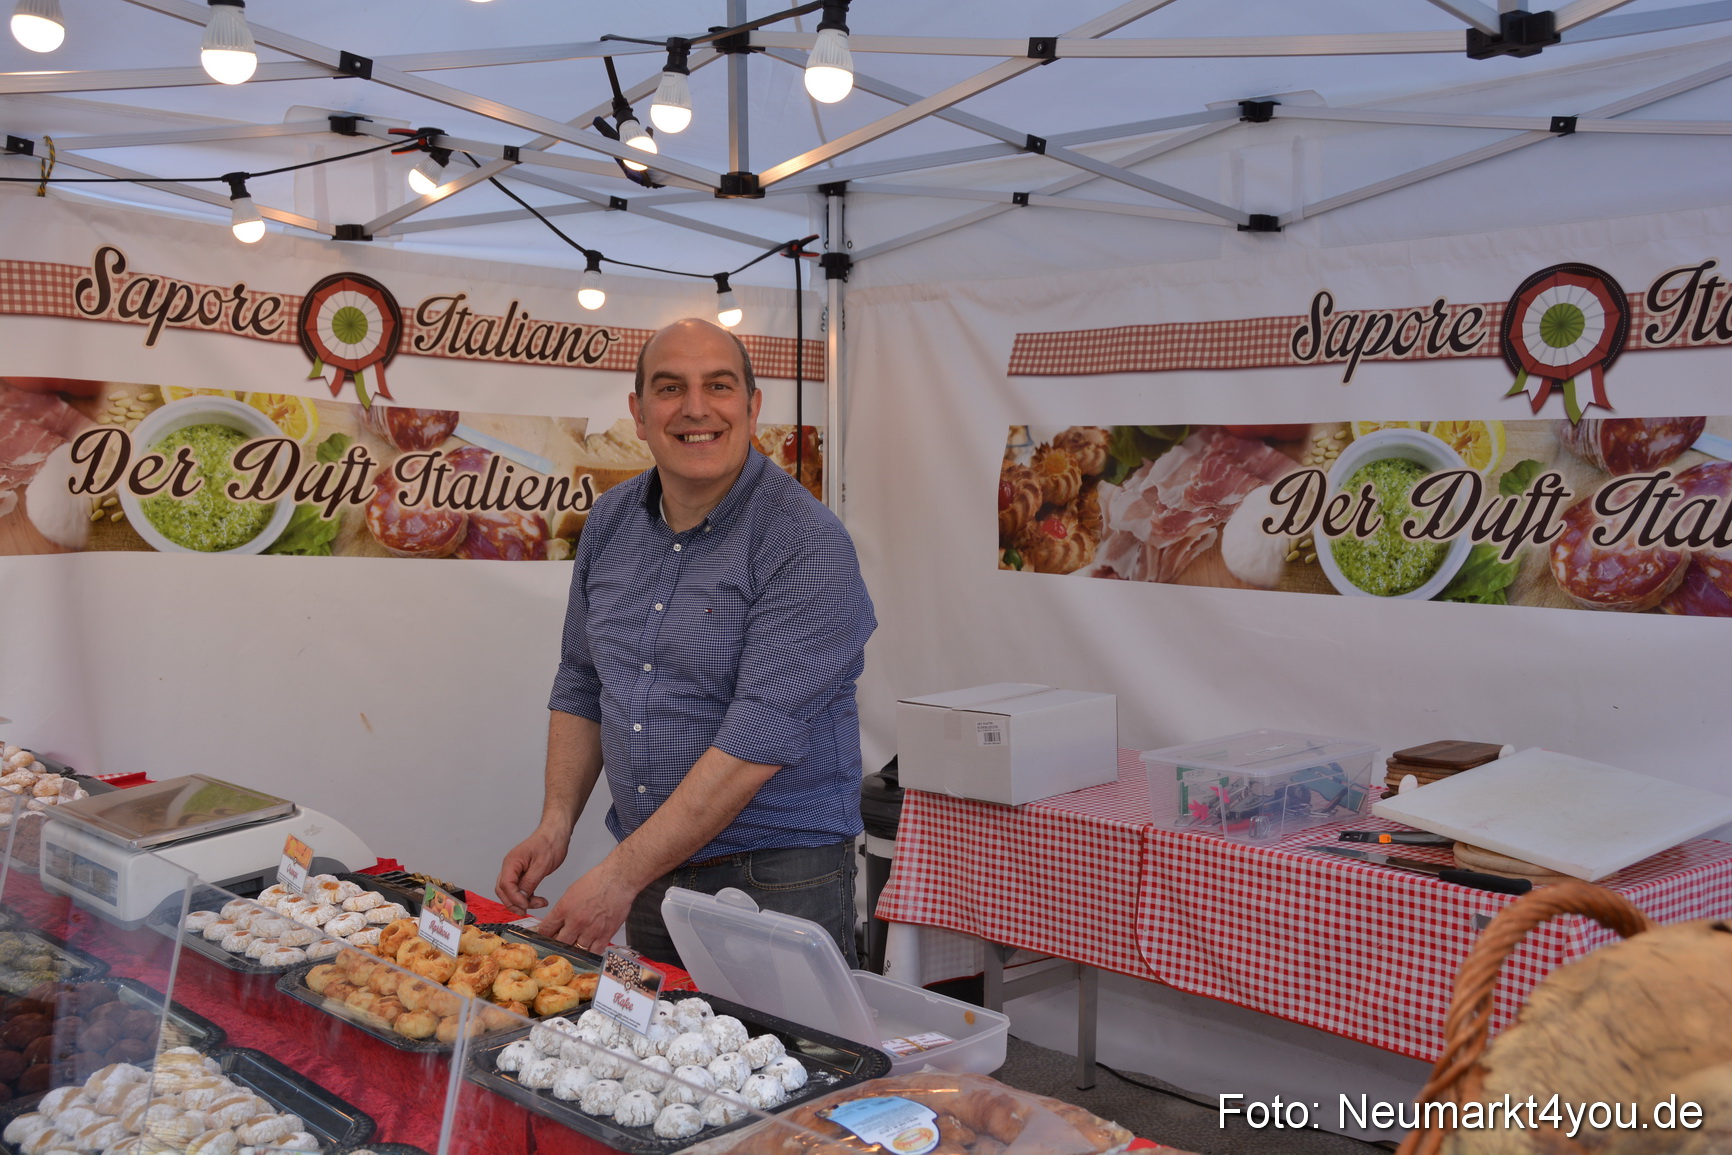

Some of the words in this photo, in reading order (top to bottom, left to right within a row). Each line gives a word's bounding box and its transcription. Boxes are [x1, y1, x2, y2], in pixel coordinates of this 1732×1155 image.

[74, 246, 286, 347] Sapore
[413, 293, 621, 365] Italiano
[1291, 290, 1487, 384] Sapore
[68, 428, 202, 498] Der
[227, 438, 379, 519] Duft
[394, 450, 595, 512] Italiens
[1261, 469, 1381, 539] Der
[1403, 472, 1572, 561] Duft
